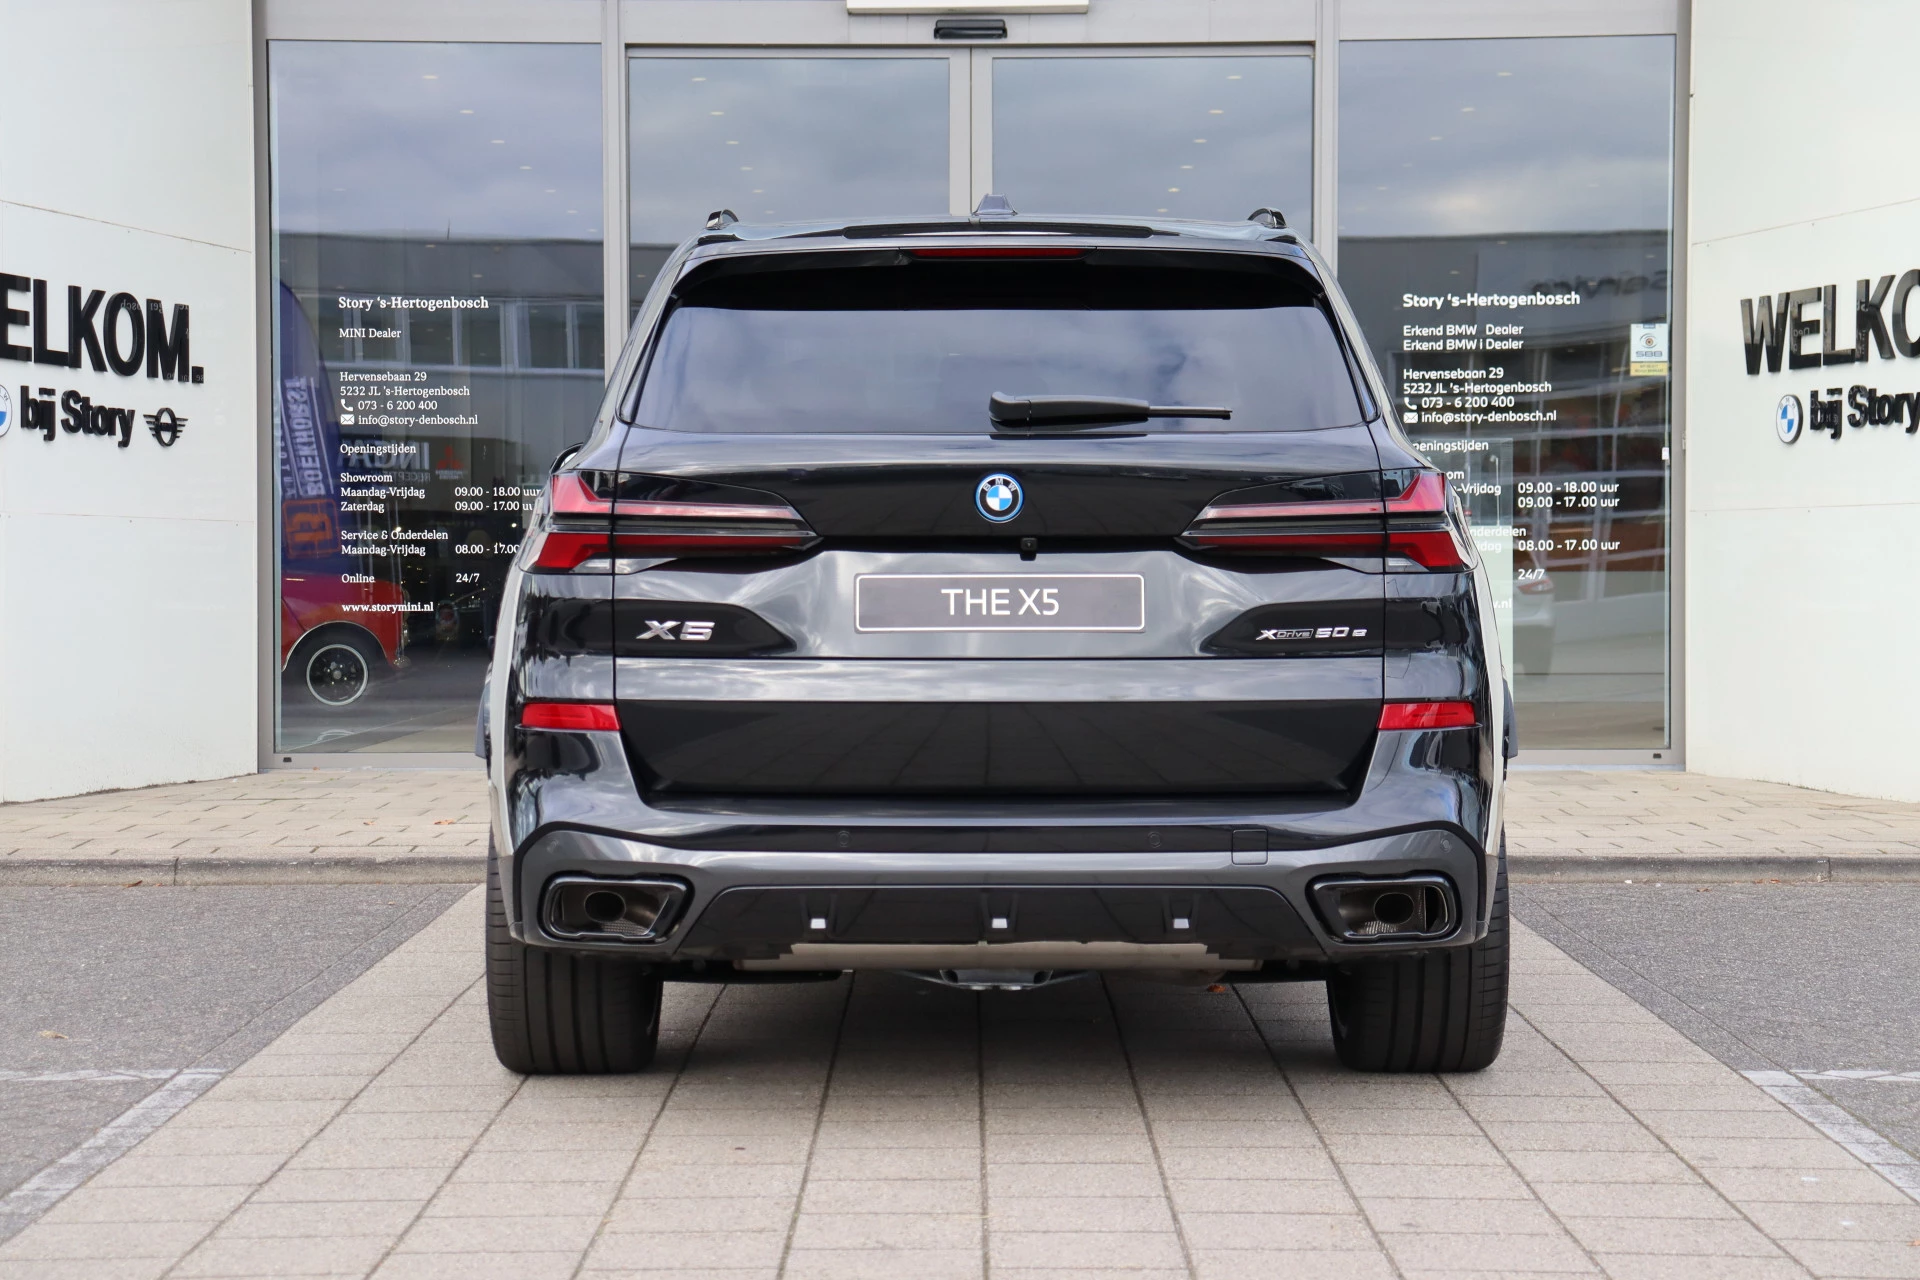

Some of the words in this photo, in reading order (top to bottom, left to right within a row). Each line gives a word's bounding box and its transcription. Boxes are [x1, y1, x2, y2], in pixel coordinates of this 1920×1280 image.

[338, 296, 374, 312] Story
[1402, 293, 1445, 310] Story
[0, 272, 204, 384] ELKOM.
[1740, 268, 1920, 376] WELKO
[339, 327, 366, 338] MINI
[368, 327, 402, 338] Dealer
[1403, 324, 1444, 337] Erkend
[1446, 323, 1478, 336] BMW
[1485, 323, 1524, 336] Dealer
[1403, 338, 1444, 351] Erkend
[1446, 338, 1478, 351] BMW
[1479, 338, 1483, 350] i
[1485, 338, 1524, 350] Dealer
[339, 371, 412, 382] Hervensebaan
[414, 371, 428, 382] 29
[1403, 368, 1487, 380] Hervensebaan
[1488, 367, 1504, 379] 29
[339, 385, 366, 396] 5232
[368, 385, 381, 396] JL
[1403, 382, 1432, 395] 5232
[1433, 382, 1448, 395] JL
[357, 400, 378, 411] 073
[386, 400, 394, 411] 6
[396, 400, 416, 411] 200
[417, 400, 438, 411] 400
[1421, 396, 1444, 409] 073
[1454, 396, 1463, 408] 6
[1464, 396, 1489, 408] 200
[1490, 395, 1515, 408] 400
[1847, 384, 1920, 434] Story
[61, 389, 136, 448] Story
[358, 414, 479, 427] info@story-denbosch.nl
[1421, 410, 1557, 425] info@story-denbosch.nl
[339, 443, 417, 456] Openingstijden
[1412, 440, 1489, 454] peningstijden
[340, 472, 393, 483] Showroom
[340, 486, 426, 499] Maandag-Vrijdag
[454, 486, 484, 497] 09.00
[492, 486, 521, 497] 18.00
[1456, 482, 1502, 496] -Vrijdag
[1517, 482, 1553, 494] 09.00
[1563, 481, 1597, 493] 18.00
[1600, 482, 1620, 493] uur
[340, 501, 385, 514] Zaterdag
[454, 501, 484, 511] 09.00
[492, 501, 520, 511] 17.00
[1517, 496, 1553, 508] 09.00
[1600, 497, 1620, 508] uur
[341, 529, 379, 540] Service
[380, 529, 389, 540] &
[390, 529, 449, 540] Onderdelen
[1469, 526, 1527, 537] nderdelen
[341, 543, 426, 556] Maandag-Vrijdag
[455, 544, 484, 554] 08.00
[1517, 539, 1554, 552] 08.00
[1601, 540, 1620, 551] uur
[341, 573, 376, 584] Online
[455, 573, 480, 583] 24/7
[1517, 568, 1545, 580] 24/7
[341, 601, 435, 614] www.storymini.nl
[940, 588, 1011, 616] THE
[1018, 588, 1060, 616] X5
[635, 620, 716, 641] X5
